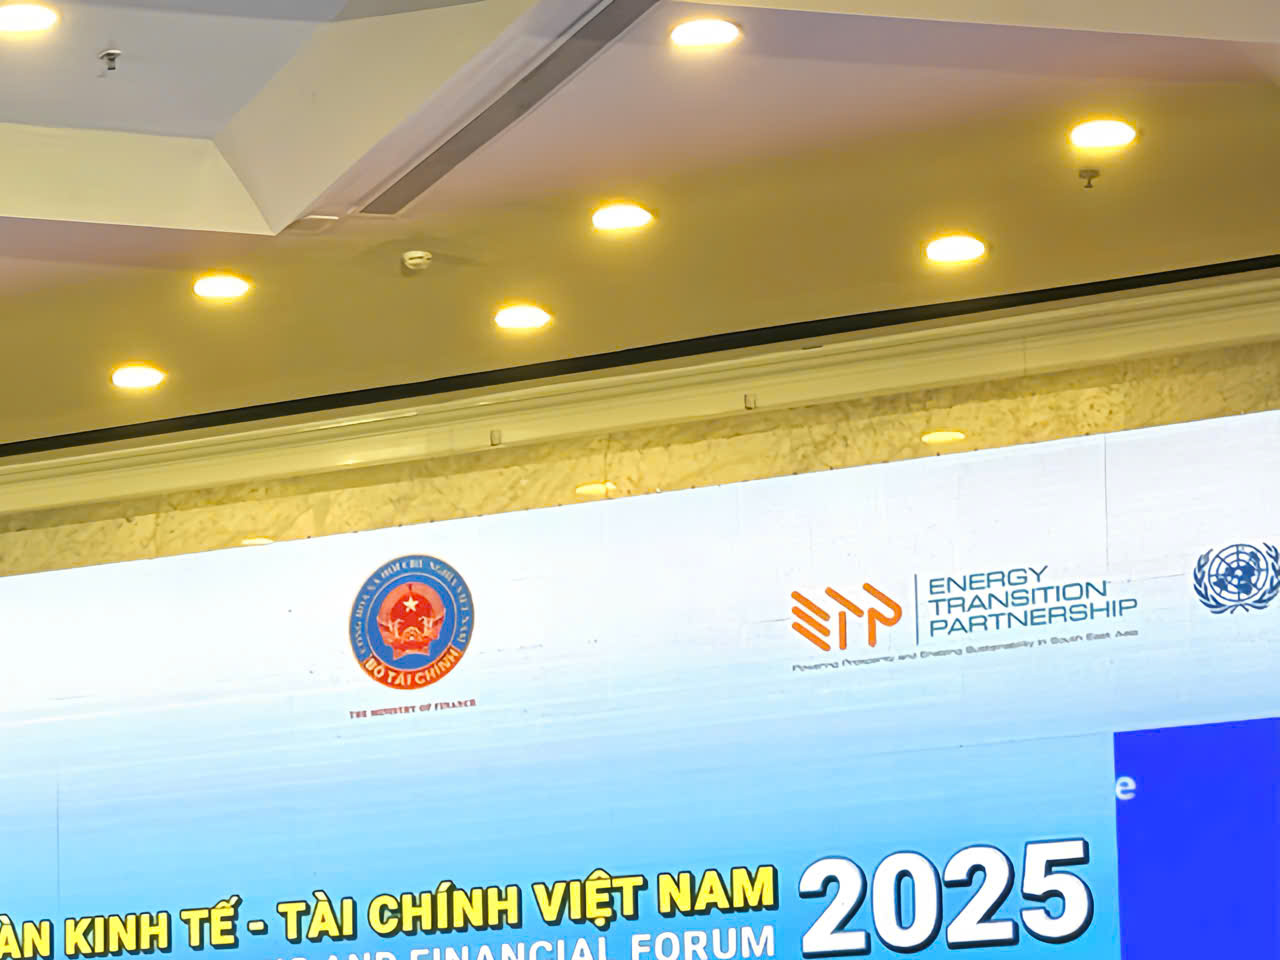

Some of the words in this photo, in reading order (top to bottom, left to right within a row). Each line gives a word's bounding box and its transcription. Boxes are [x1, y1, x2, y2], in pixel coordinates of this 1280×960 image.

[928, 580, 1108, 616] TRANSITION
[929, 565, 1048, 595] ENERGY
[929, 598, 1138, 637] PARTNERSHIP
[64, 910, 169, 959] KINH
[180, 895, 241, 951] TẾ
[276, 890, 357, 944] TÀI
[367, 880, 521, 938] CHÍNH
[531, 867, 647, 930] VIỆT
[657, 864, 778, 918] NAM
[798, 838, 1095, 959] 2025
